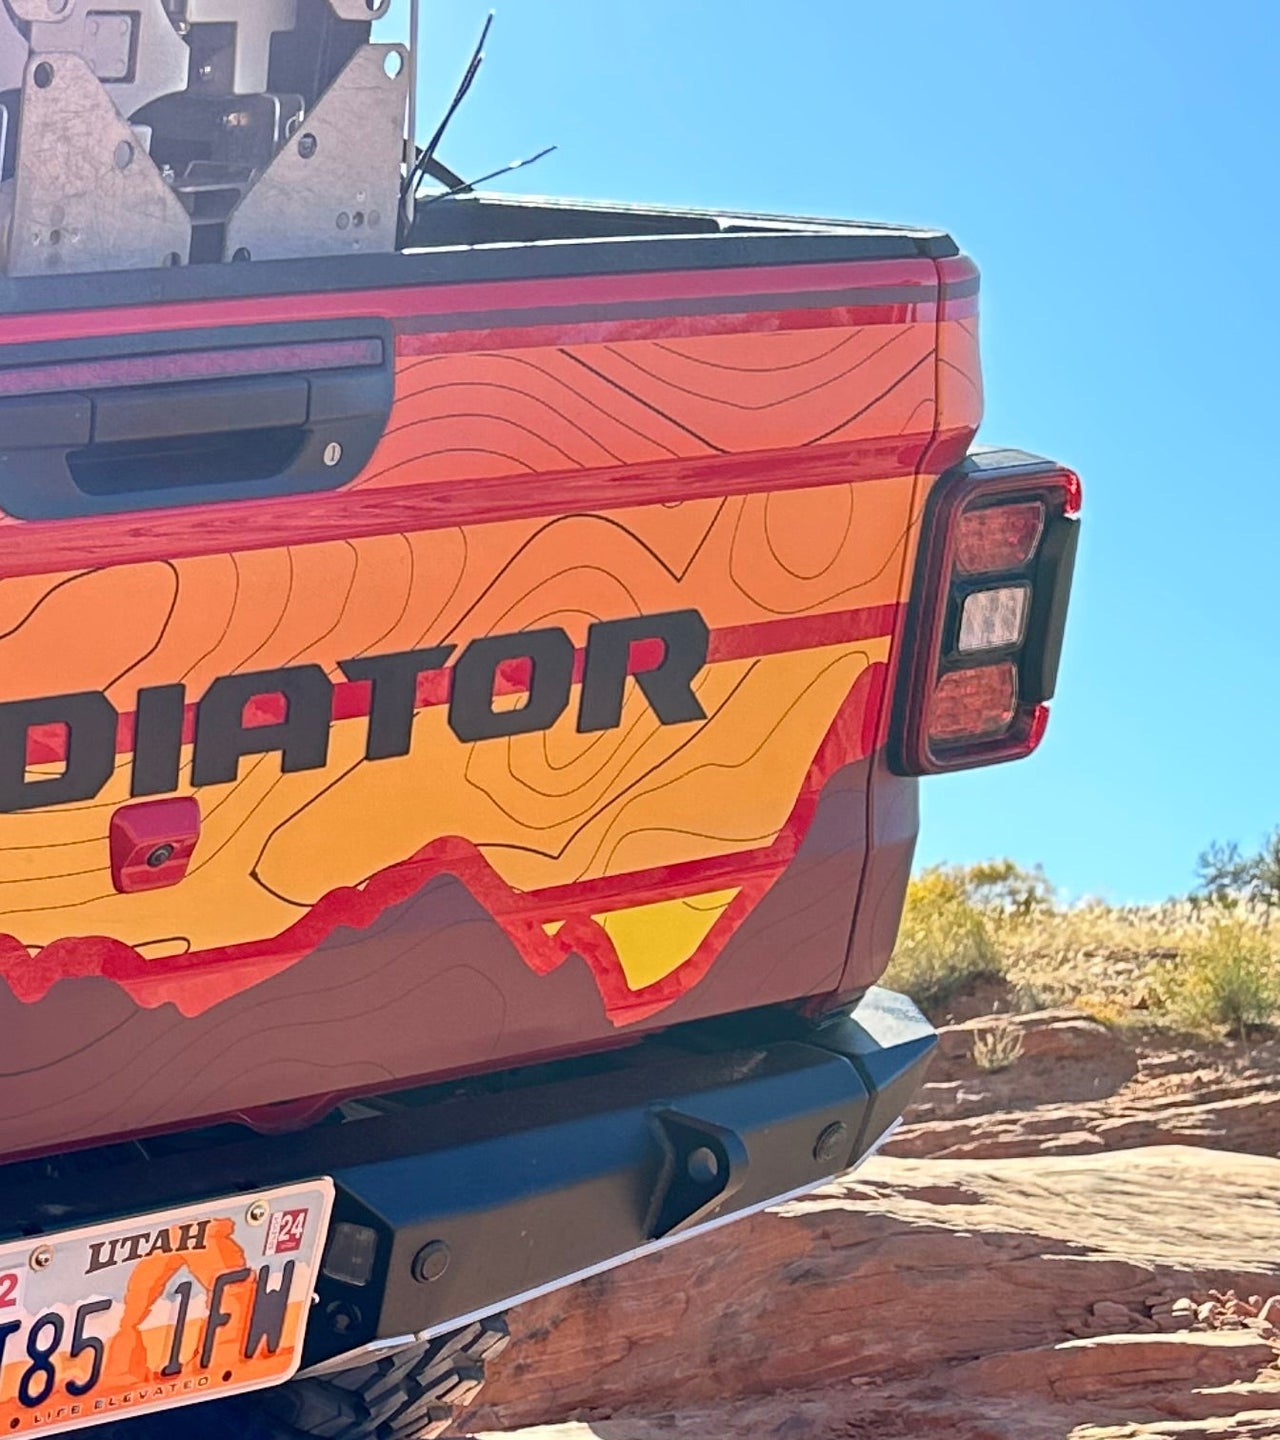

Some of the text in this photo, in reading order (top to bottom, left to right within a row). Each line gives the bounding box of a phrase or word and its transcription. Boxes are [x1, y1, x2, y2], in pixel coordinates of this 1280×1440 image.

[85, 1219, 211, 1275] UTAH
[278, 1212, 306, 1243] 24
[161, 1259, 295, 1377] 1FW
[33, 1376, 209, 1424] LIFE ELEVATED
